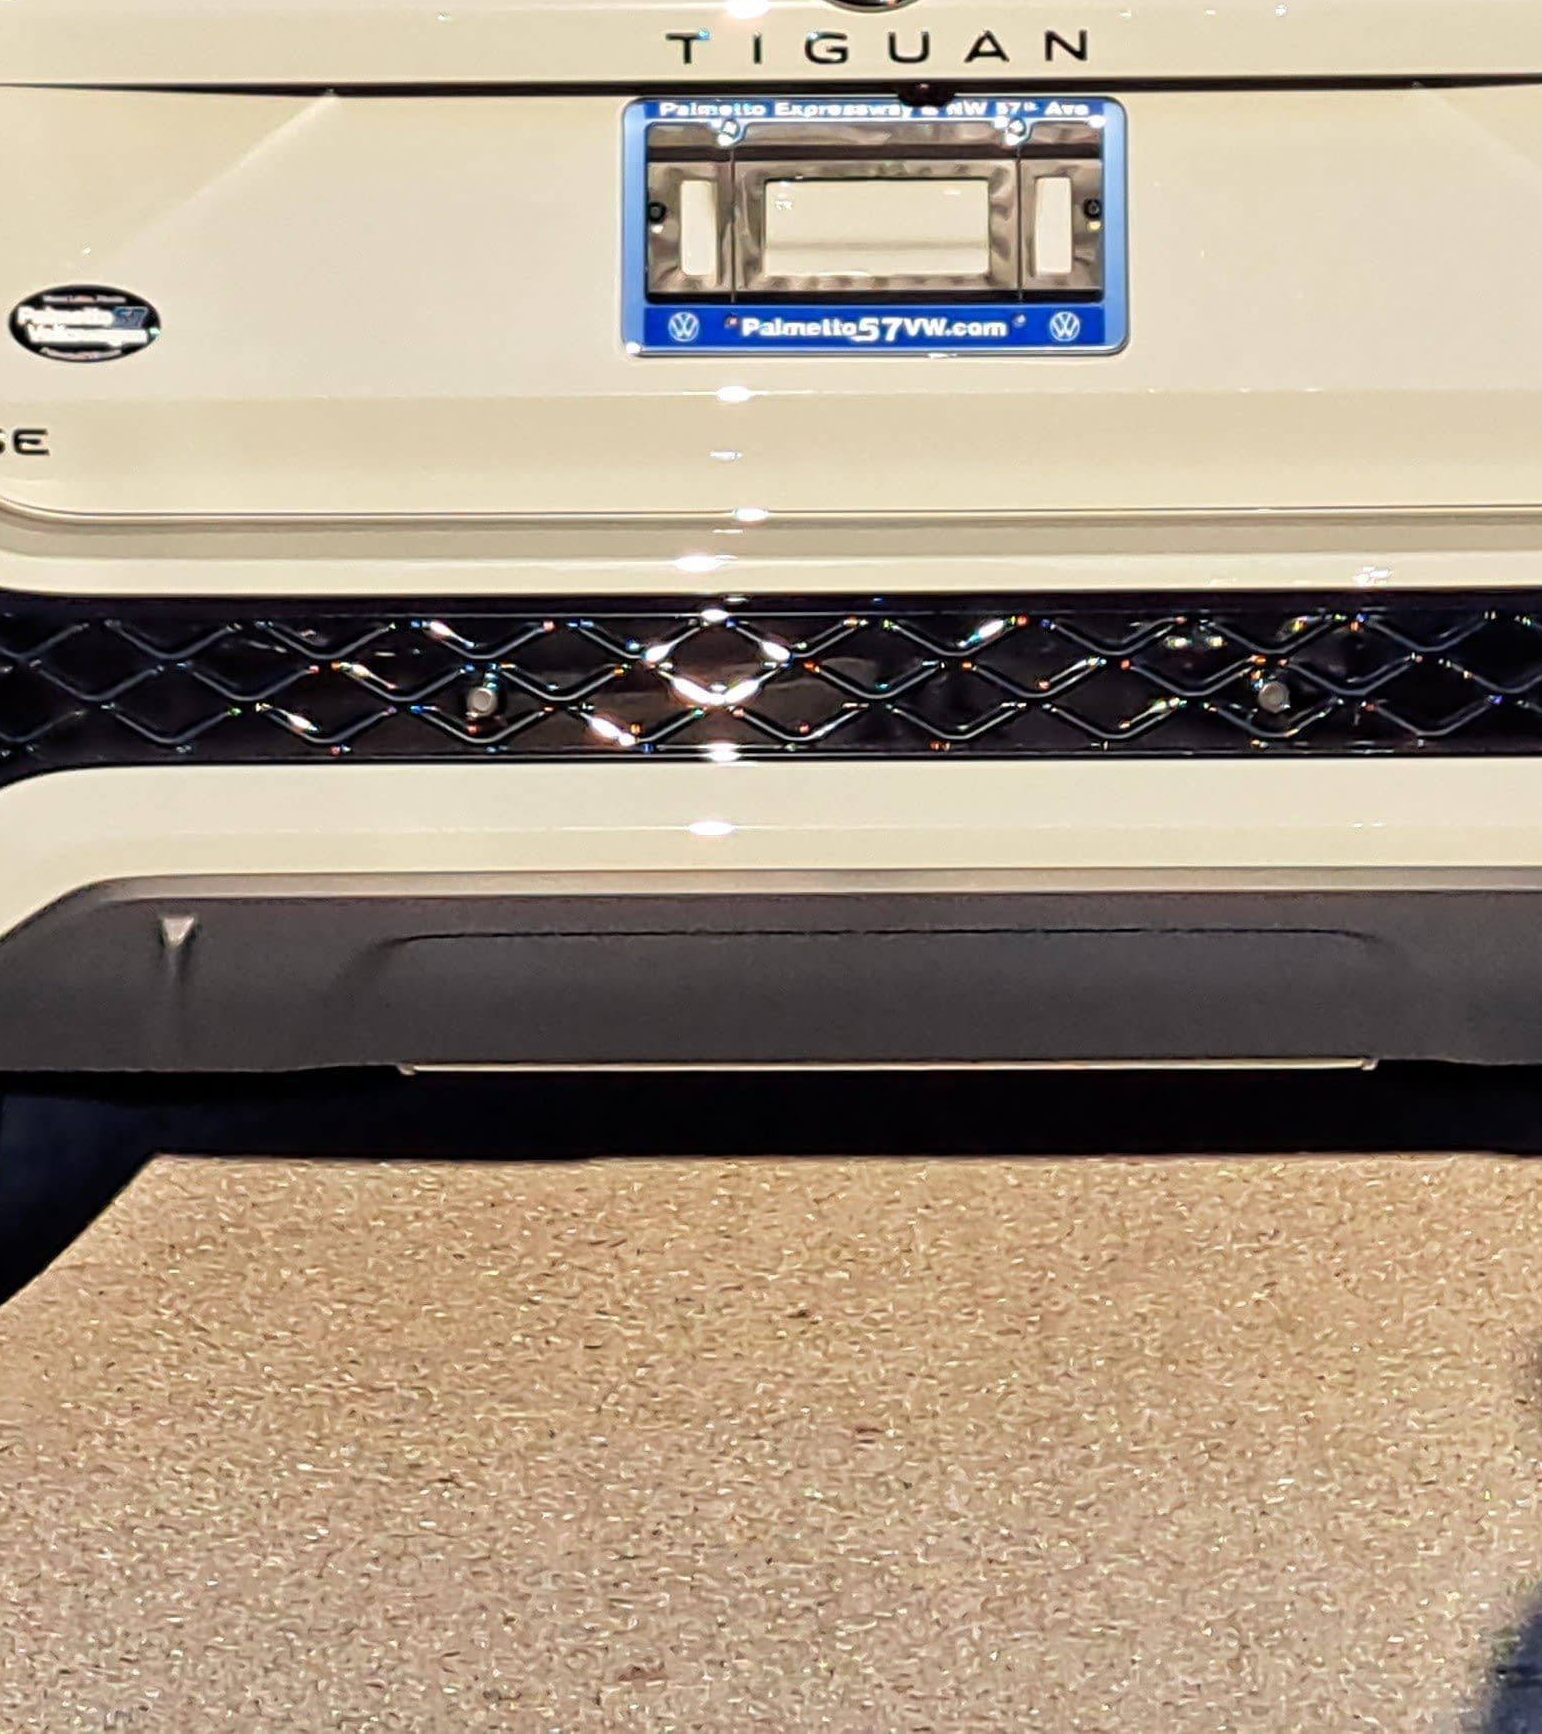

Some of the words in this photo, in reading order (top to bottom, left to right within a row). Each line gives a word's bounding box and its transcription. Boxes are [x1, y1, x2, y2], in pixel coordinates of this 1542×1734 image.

[666, 30, 1088, 64] TIGUAN
[659, 101, 766, 116] Palmetto
[774, 102, 913, 118] Expressway
[946, 100, 988, 116] NW
[1044, 101, 1090, 116] Ave
[740, 317, 1008, 342] Palmetto57VW.com
